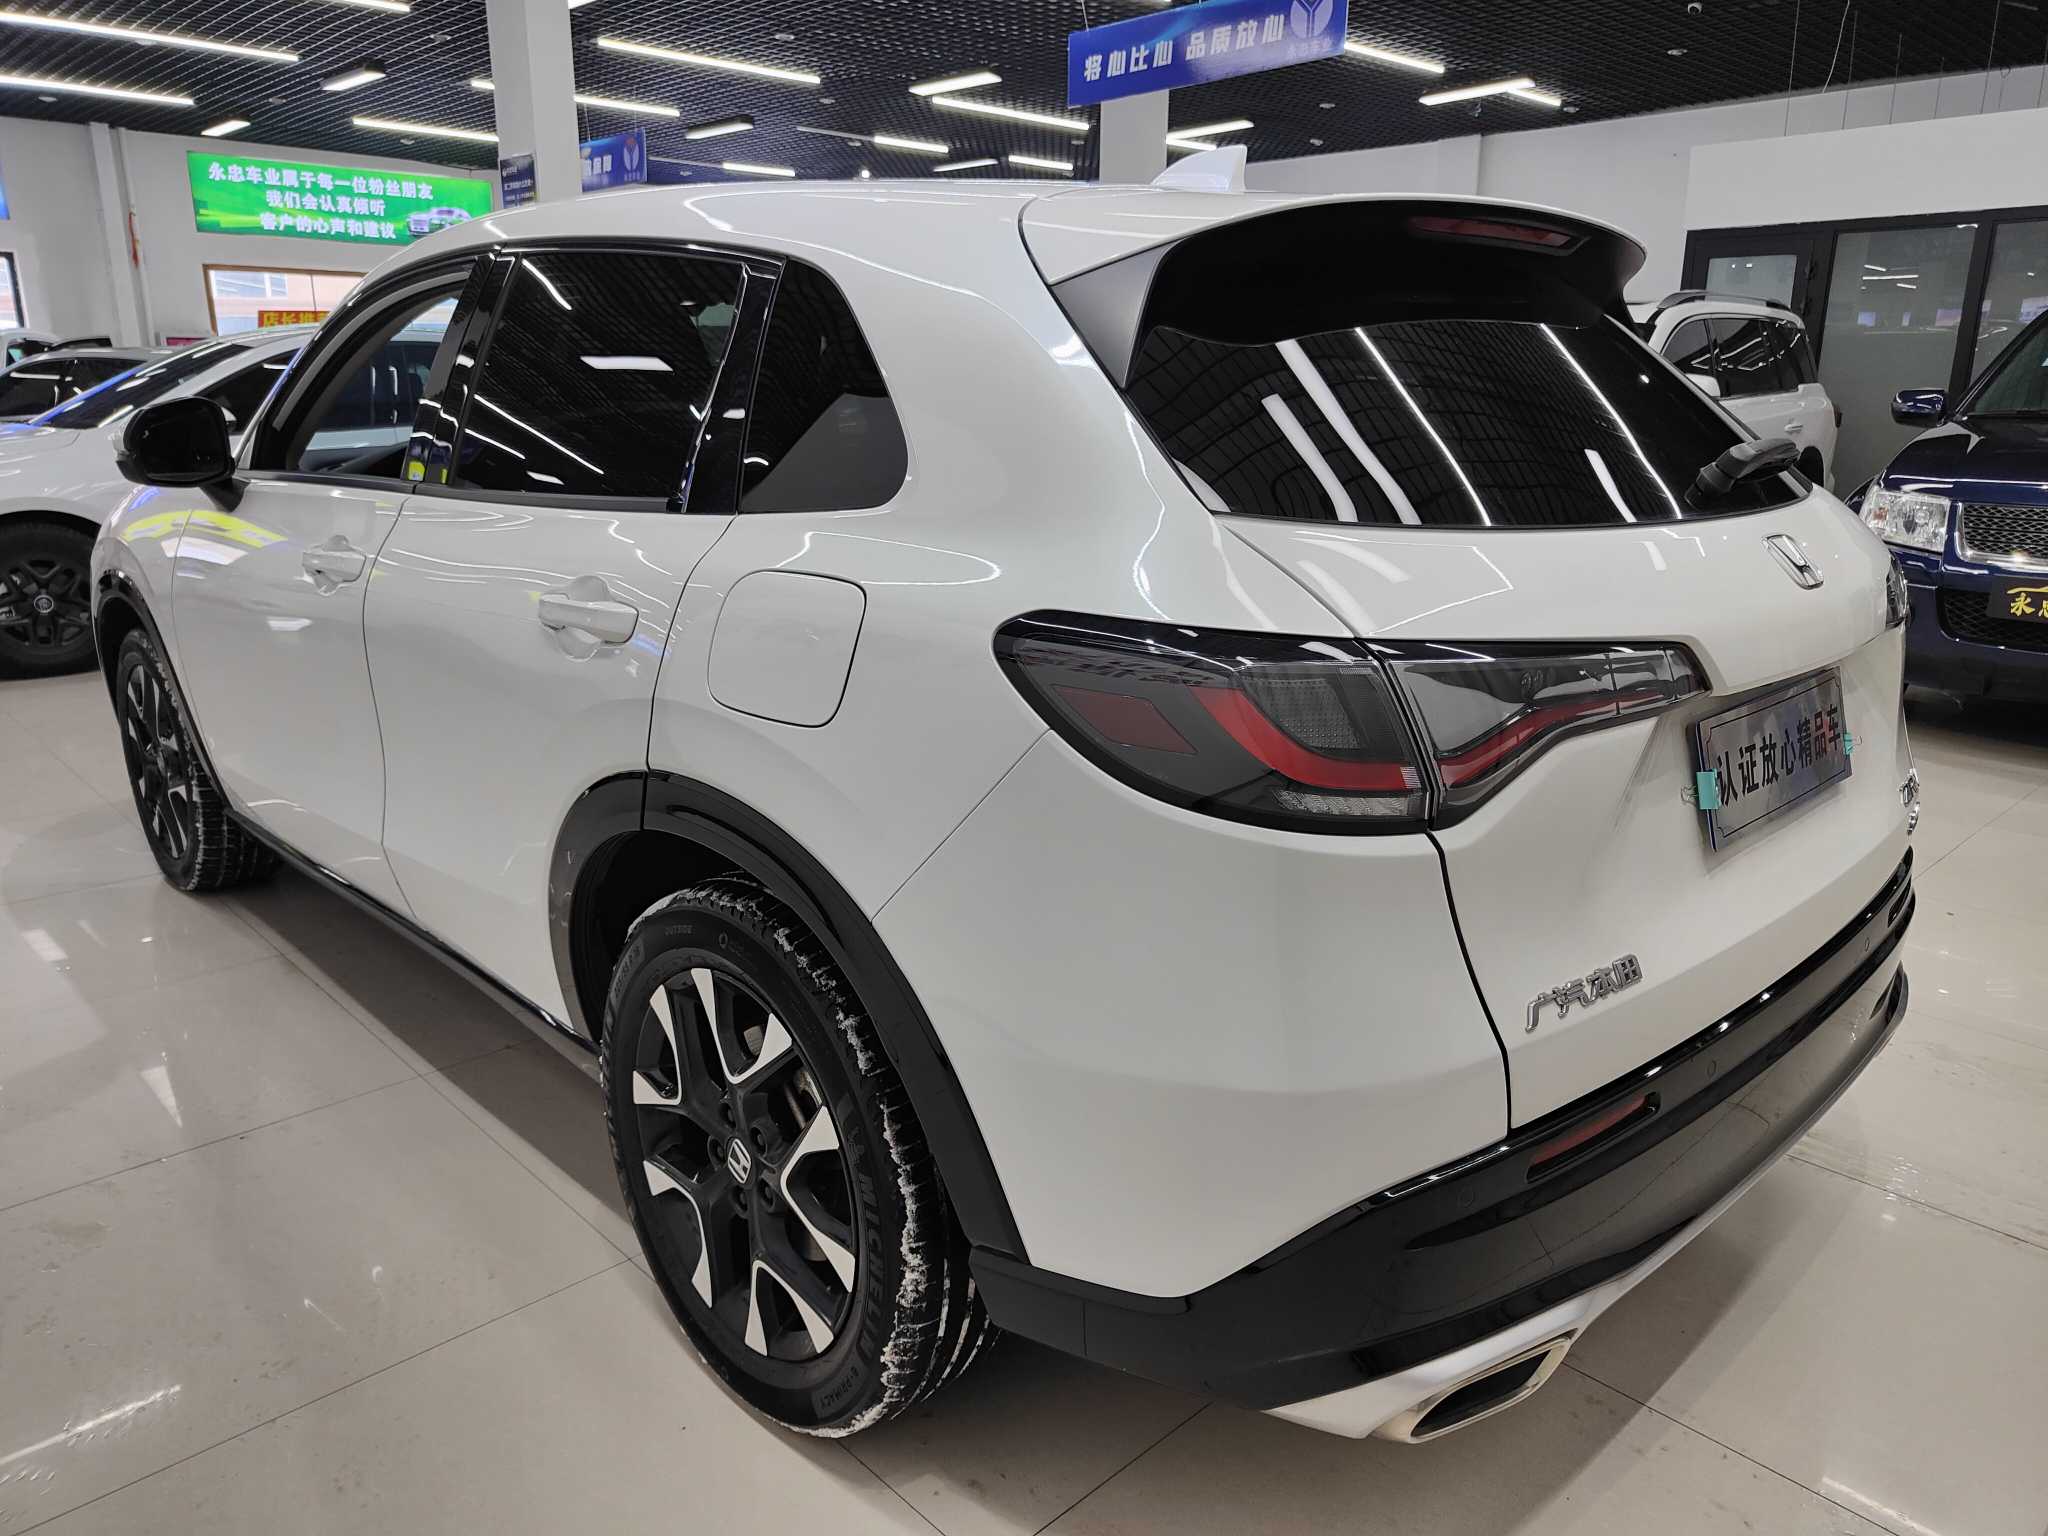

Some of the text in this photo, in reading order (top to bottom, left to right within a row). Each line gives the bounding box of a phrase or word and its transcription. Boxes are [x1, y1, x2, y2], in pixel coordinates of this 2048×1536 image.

[1084, 40, 1173, 82] 将心比心
[1185, 14, 1285, 61] 品质放心
[261, 212, 396, 238] 客户的心声和建议
[266, 190, 385, 216] 我们会认真倾听
[1716, 703, 1842, 807] 认证放心精品车
[1525, 954, 1643, 1033] 广汽本田
[857, 1172, 884, 1361] MICHELIN
